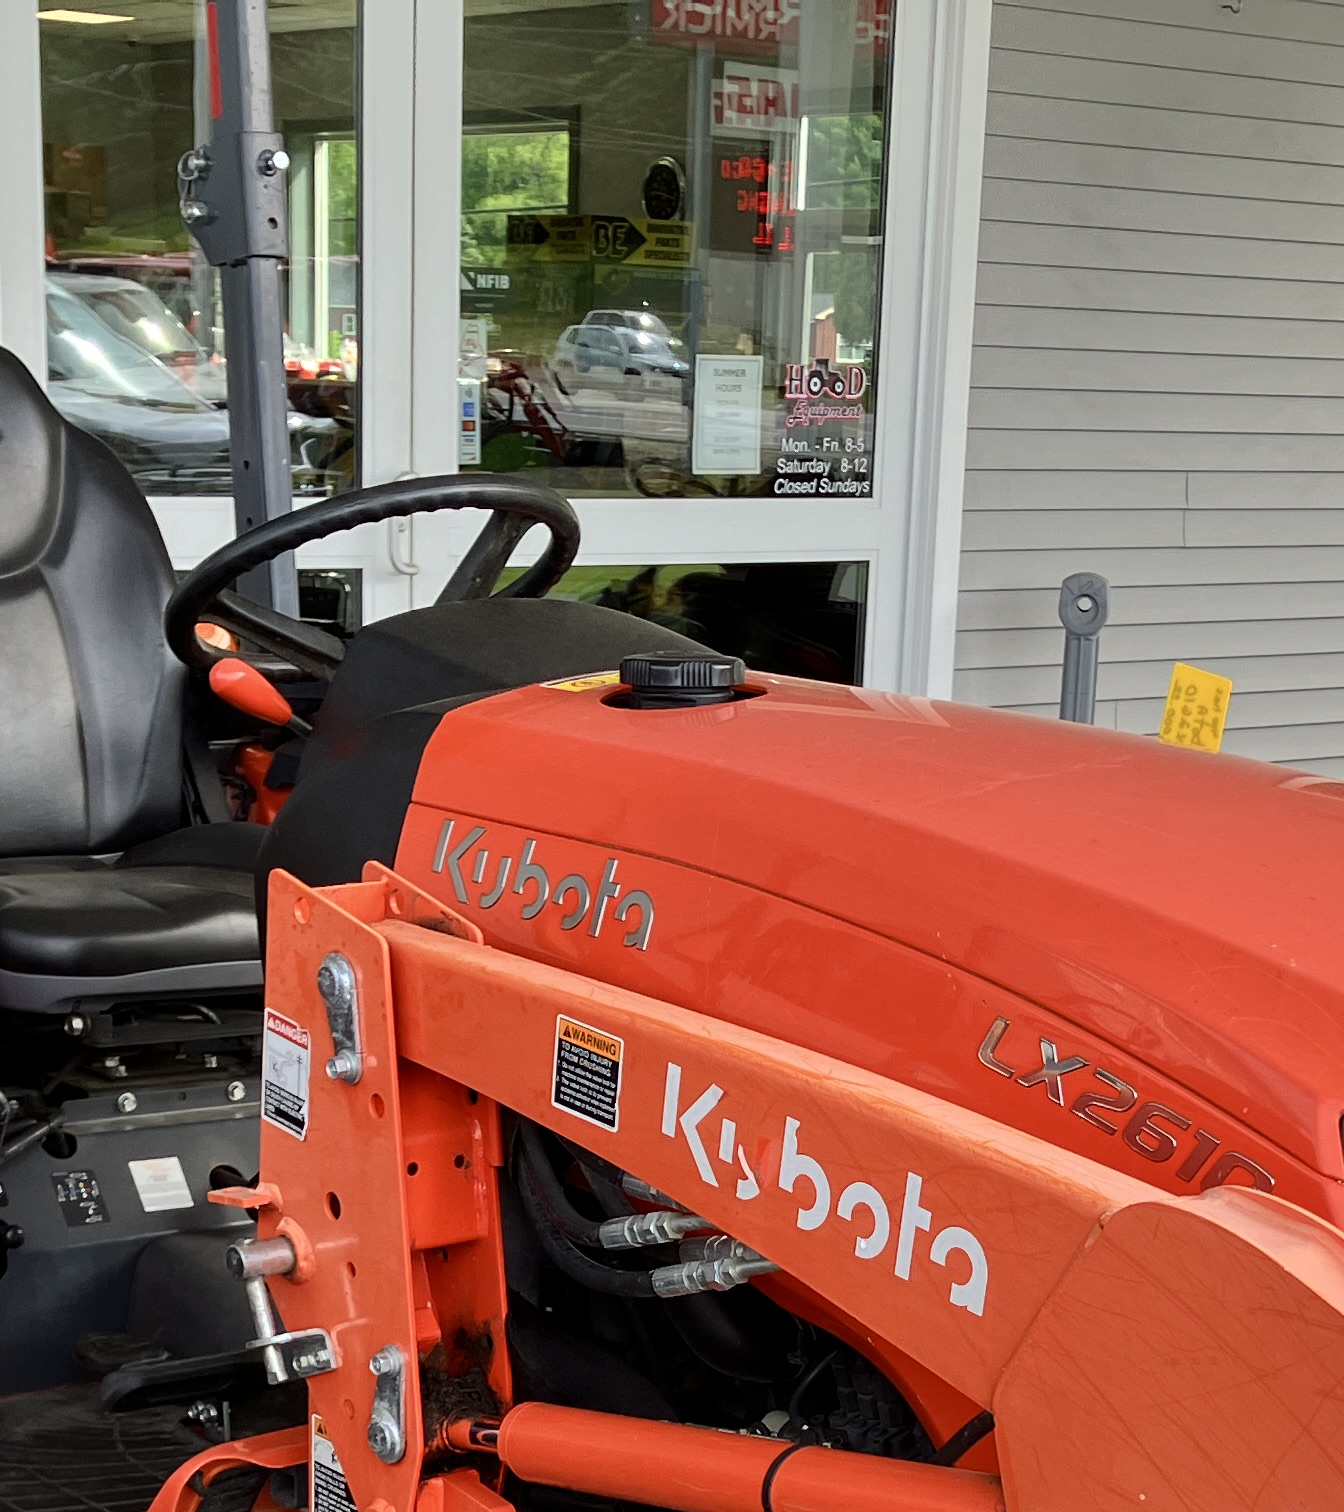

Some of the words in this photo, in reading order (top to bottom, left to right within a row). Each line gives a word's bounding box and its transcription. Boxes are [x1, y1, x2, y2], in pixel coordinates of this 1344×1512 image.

[476, 274, 510, 289] NFIB
[715, 384, 743, 393] HOURS
[786, 400, 864, 428] Equipment
[844, 438, 865, 453] 8-5
[776, 458, 831, 477] Saturday
[840, 458, 868, 473] 8-12
[774, 478, 817, 494] Closed
[818, 478, 871, 496] Sundays
[431, 818, 656, 951] Kubota
[571, 1029, 616, 1056] WARNING
[660, 1061, 989, 1318] Kubota
